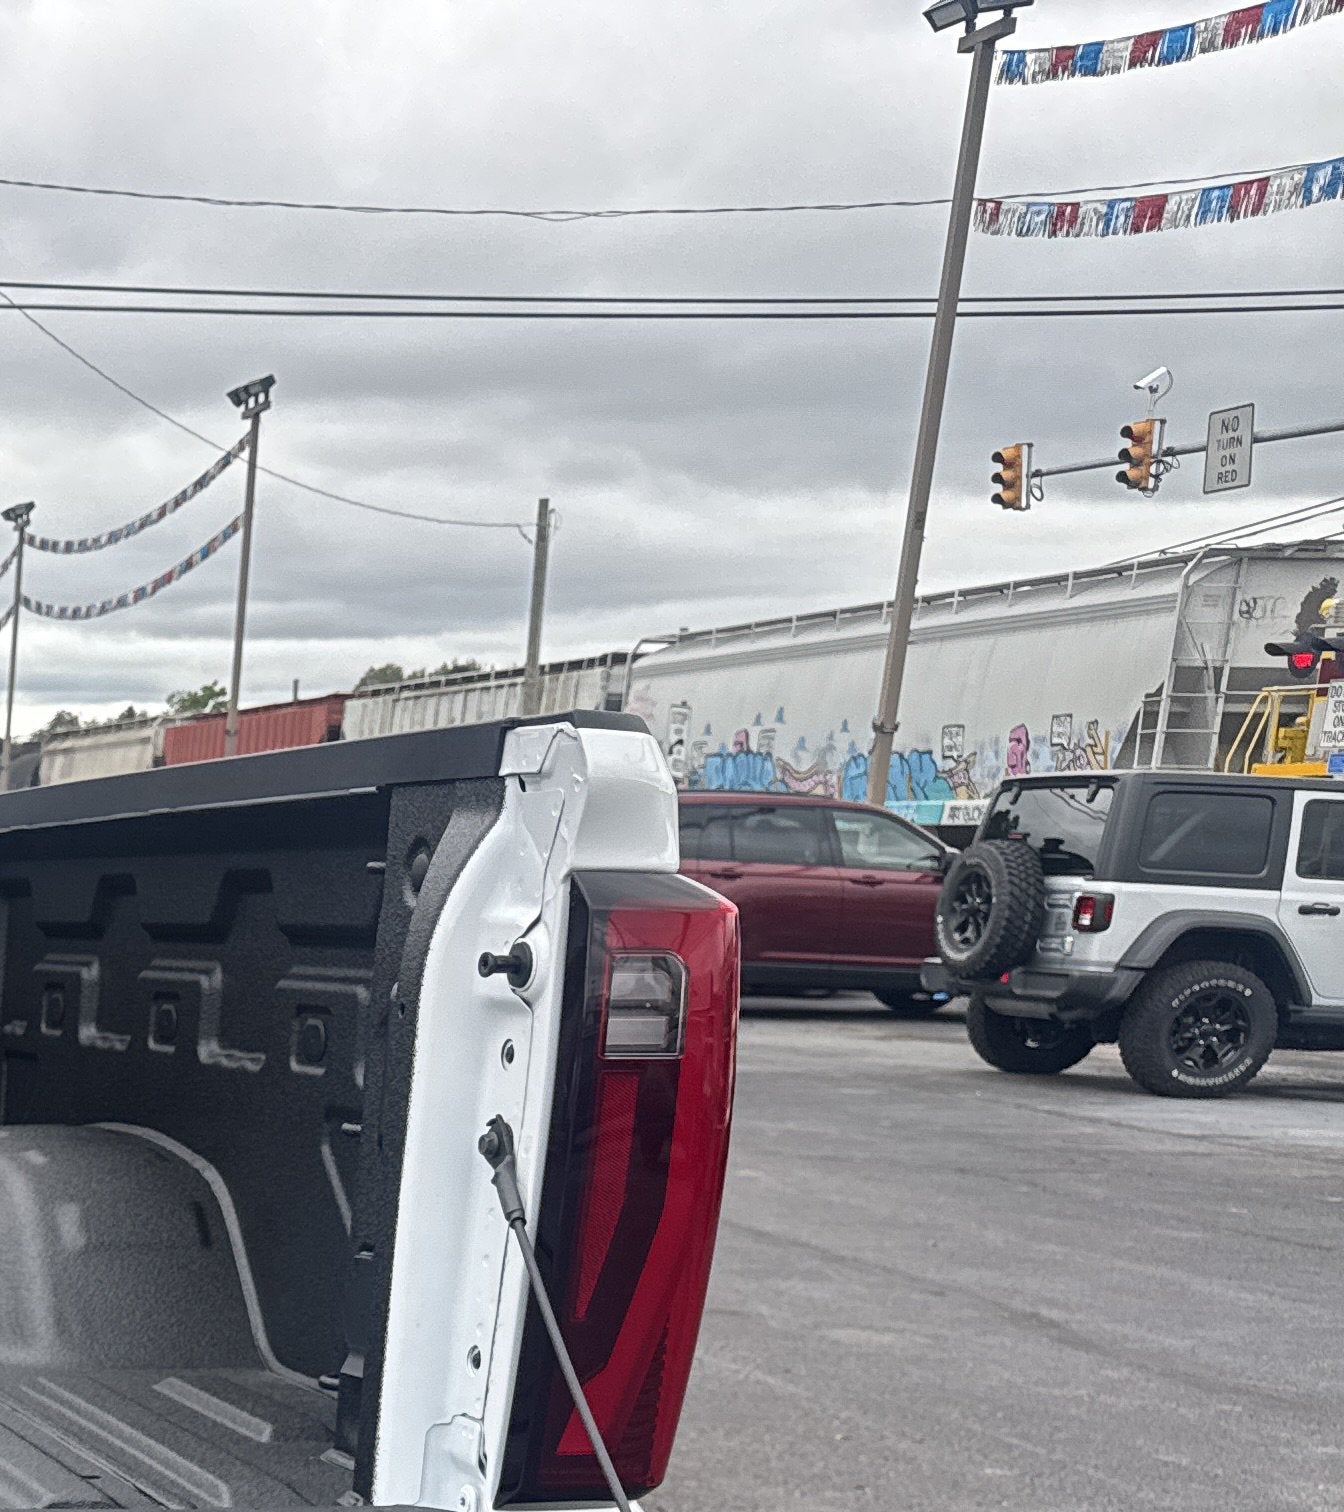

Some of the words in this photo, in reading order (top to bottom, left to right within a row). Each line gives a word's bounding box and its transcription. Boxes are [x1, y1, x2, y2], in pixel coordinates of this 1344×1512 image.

[1220, 415, 1240, 434] NO
[1216, 435, 1243, 451] TURN
[1220, 453, 1236, 468] ON
[1216, 469, 1238, 485] RED
[1321, 730, 1344, 744] TRAC
